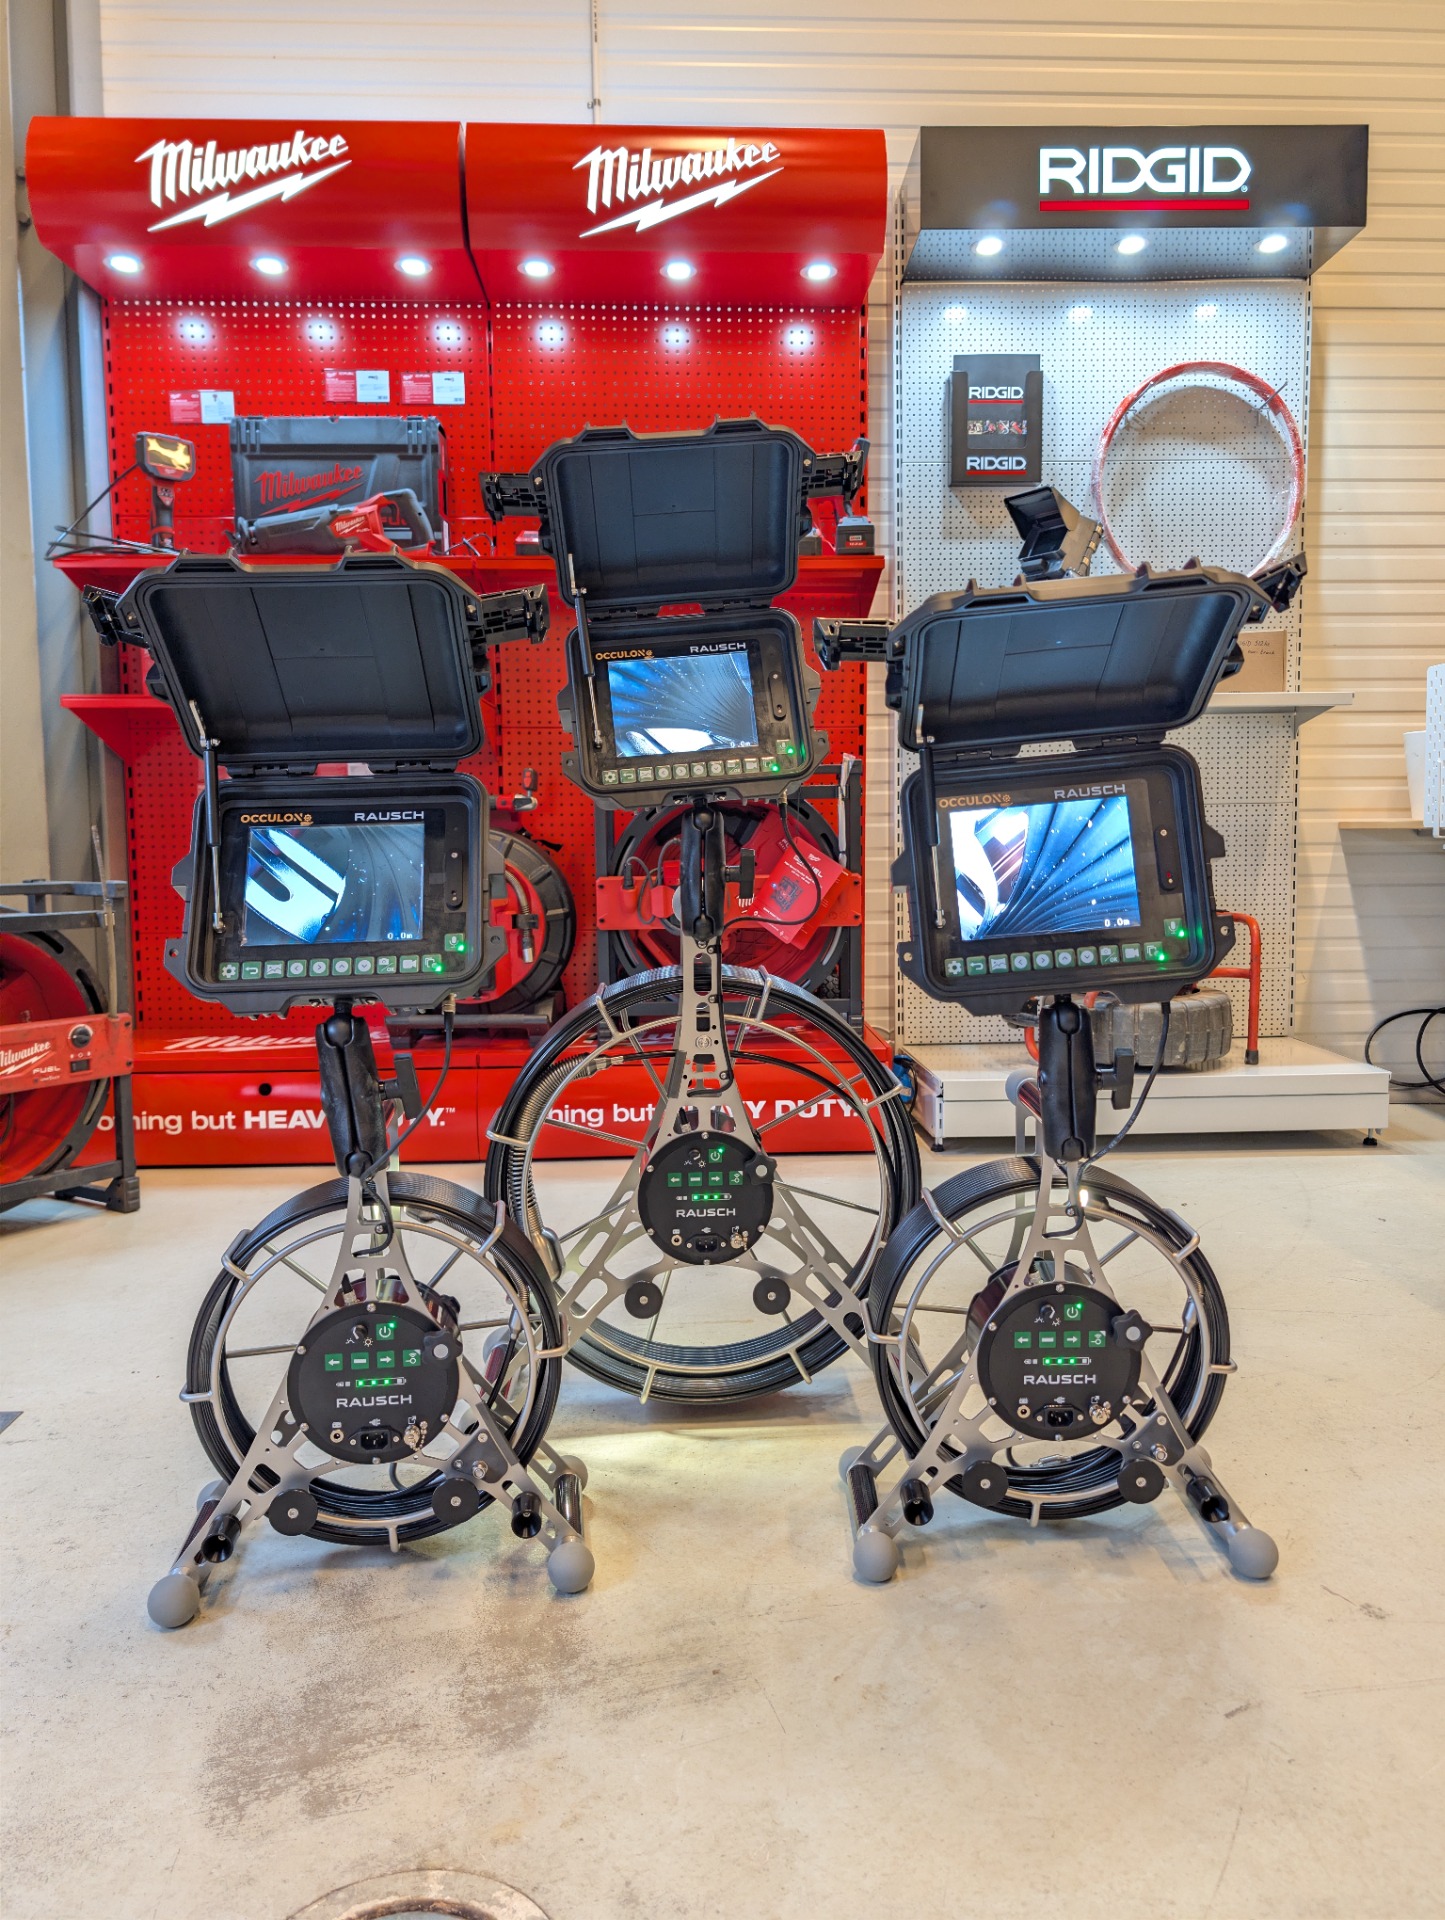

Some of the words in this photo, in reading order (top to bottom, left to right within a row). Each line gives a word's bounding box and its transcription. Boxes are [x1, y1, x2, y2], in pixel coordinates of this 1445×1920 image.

[134, 130, 349, 209] Milwaukee
[572, 137, 781, 215] Milwaukee
[254, 463, 364, 505] Milwaukee
[690, 642, 747, 653] RAUSCH
[1054, 784, 1126, 799] RAUSCH
[354, 811, 425, 822] RAUSCH
[191, 1110, 236, 1130] but
[244, 1110, 327, 1129] HEAV
[613, 1104, 656, 1122] but
[676, 1208, 736, 1218] RAUSCH
[1023, 1374, 1097, 1385] RAUSCH
[336, 1394, 412, 1408] RAUSCH
